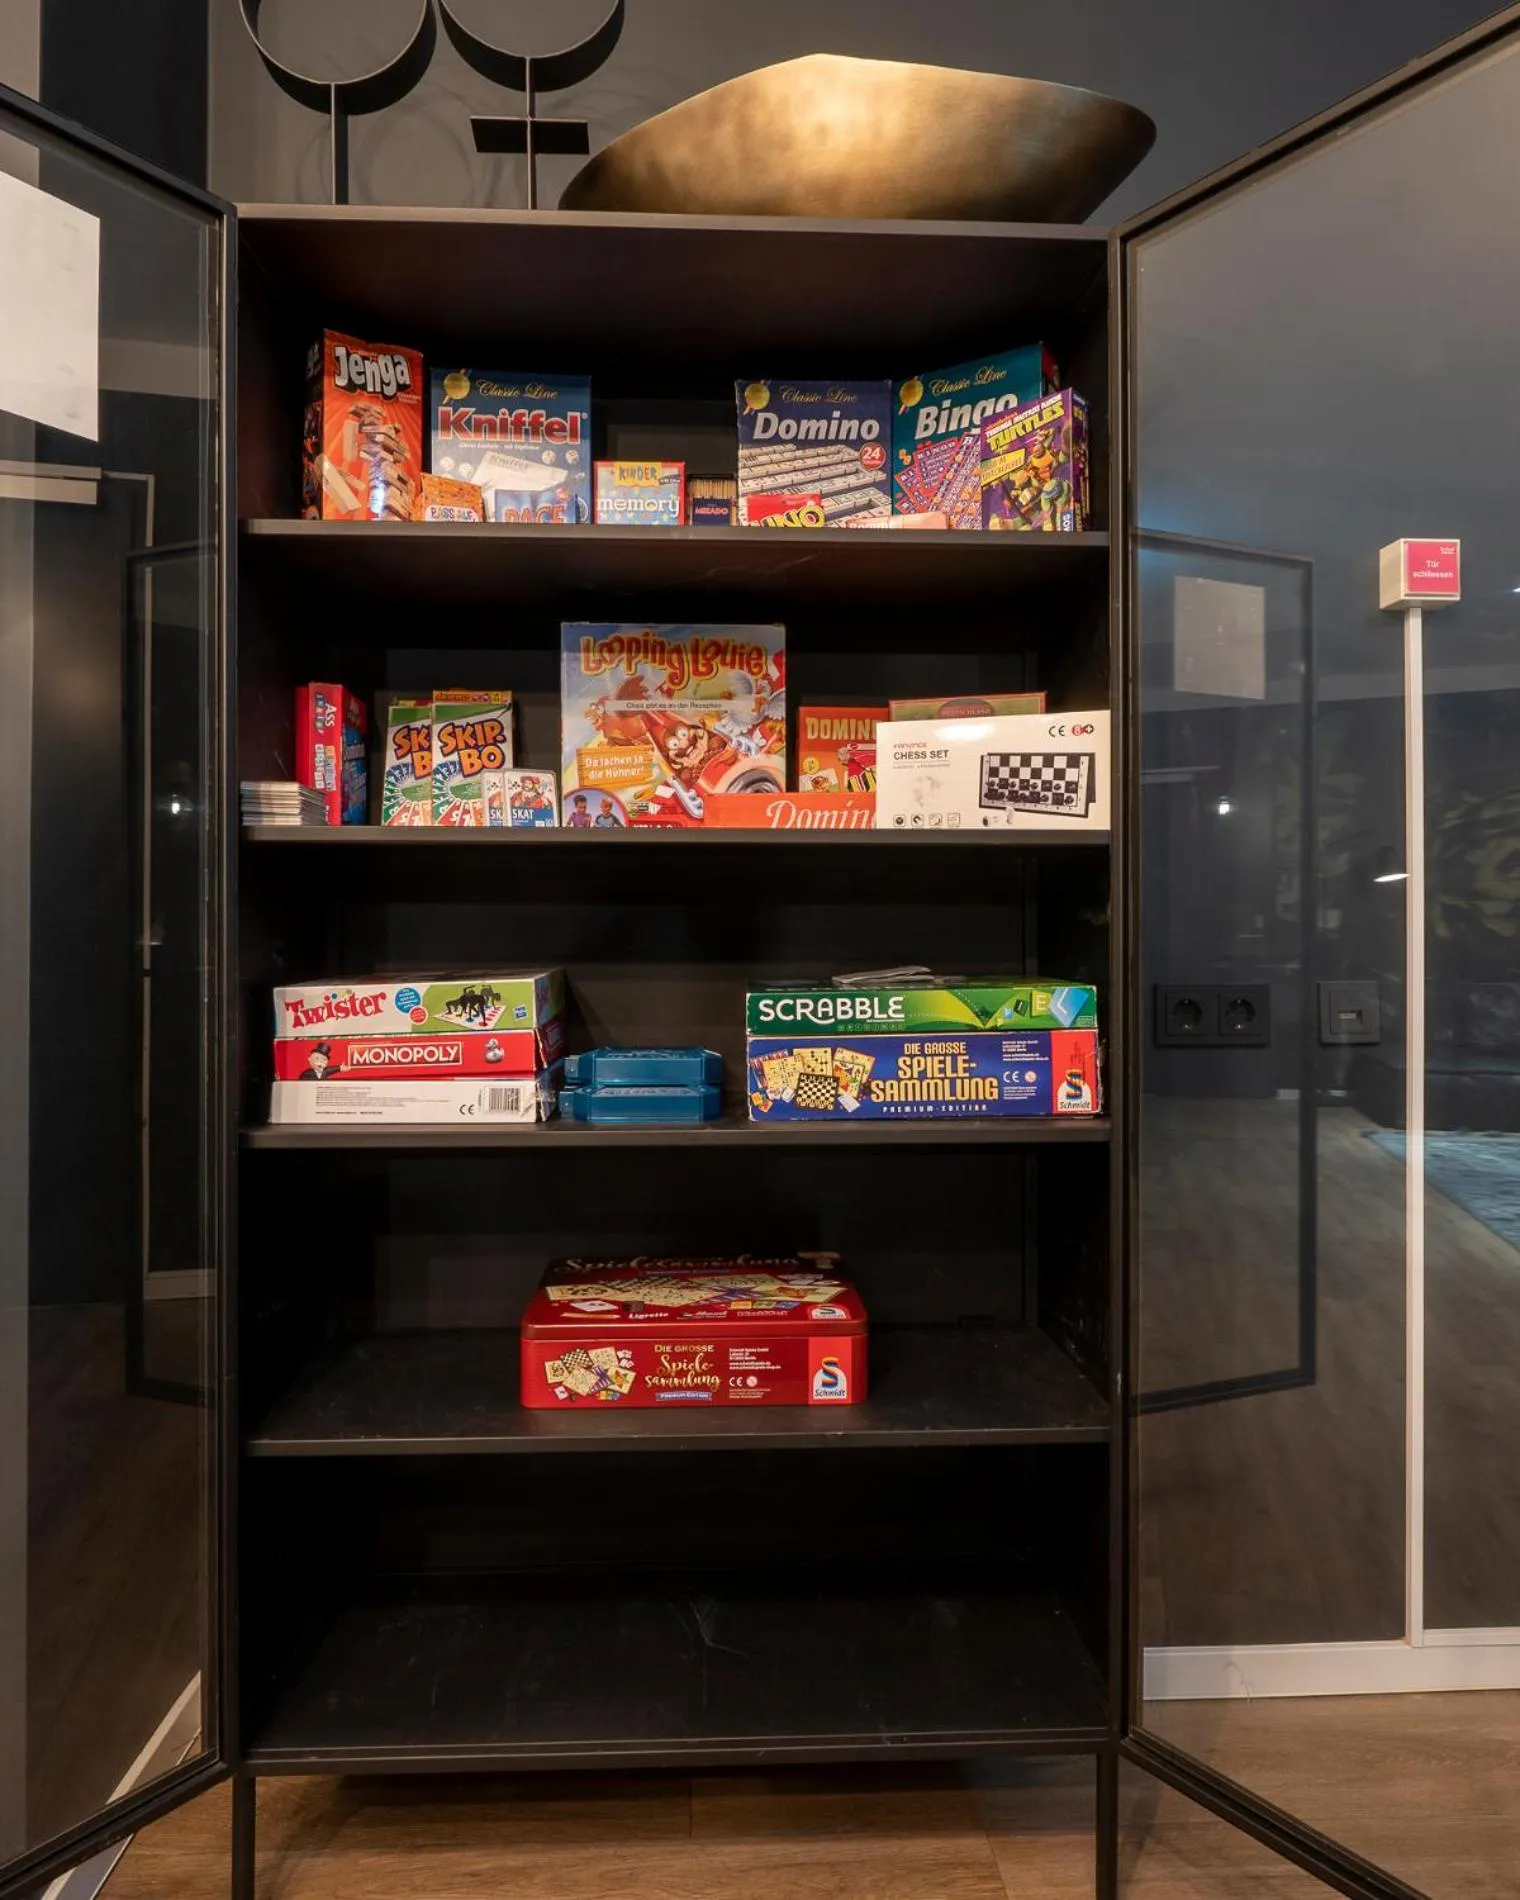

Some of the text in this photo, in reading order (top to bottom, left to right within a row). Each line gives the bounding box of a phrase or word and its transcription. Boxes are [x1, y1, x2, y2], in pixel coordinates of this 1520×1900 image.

[334, 346, 411, 397] Jenga
[929, 364, 1008, 398] Classic Line
[475, 378, 558, 400] Classic Line
[779, 384, 858, 404] Classic Line
[437, 406, 582, 445] Kniffel
[752, 410, 880, 441] Domino
[985, 400, 1066, 452] TURTLES
[862, 447, 881, 461] 24
[618, 465, 658, 481] KINDER
[596, 494, 681, 519] memory
[1425, 559, 1440, 569] Tür
[579, 627, 768, 691] Looping Louie
[805, 716, 877, 741] DOMIN
[457, 743, 506, 779] BO
[893, 749, 950, 761] CHESS SET
[588, 769, 604, 780] die
[511, 808, 535, 820] SKAT
[765, 799, 877, 829] Domin
[284, 990, 388, 1029] Twister
[758, 996, 906, 1025] SCRABBLE
[352, 1045, 459, 1065] MONOPOLY
[903, 1041, 968, 1055] DIE GROSSE
[897, 1054, 978, 1079] SPIELE-
[870, 1077, 999, 1102] SAMMLUNG
[1059, 1101, 1090, 1109] Schmidt
[654, 1344, 715, 1353] DIE GROSSE
[644, 1369, 721, 1393] sammlung
[814, 1388, 846, 1397] Schmidt
